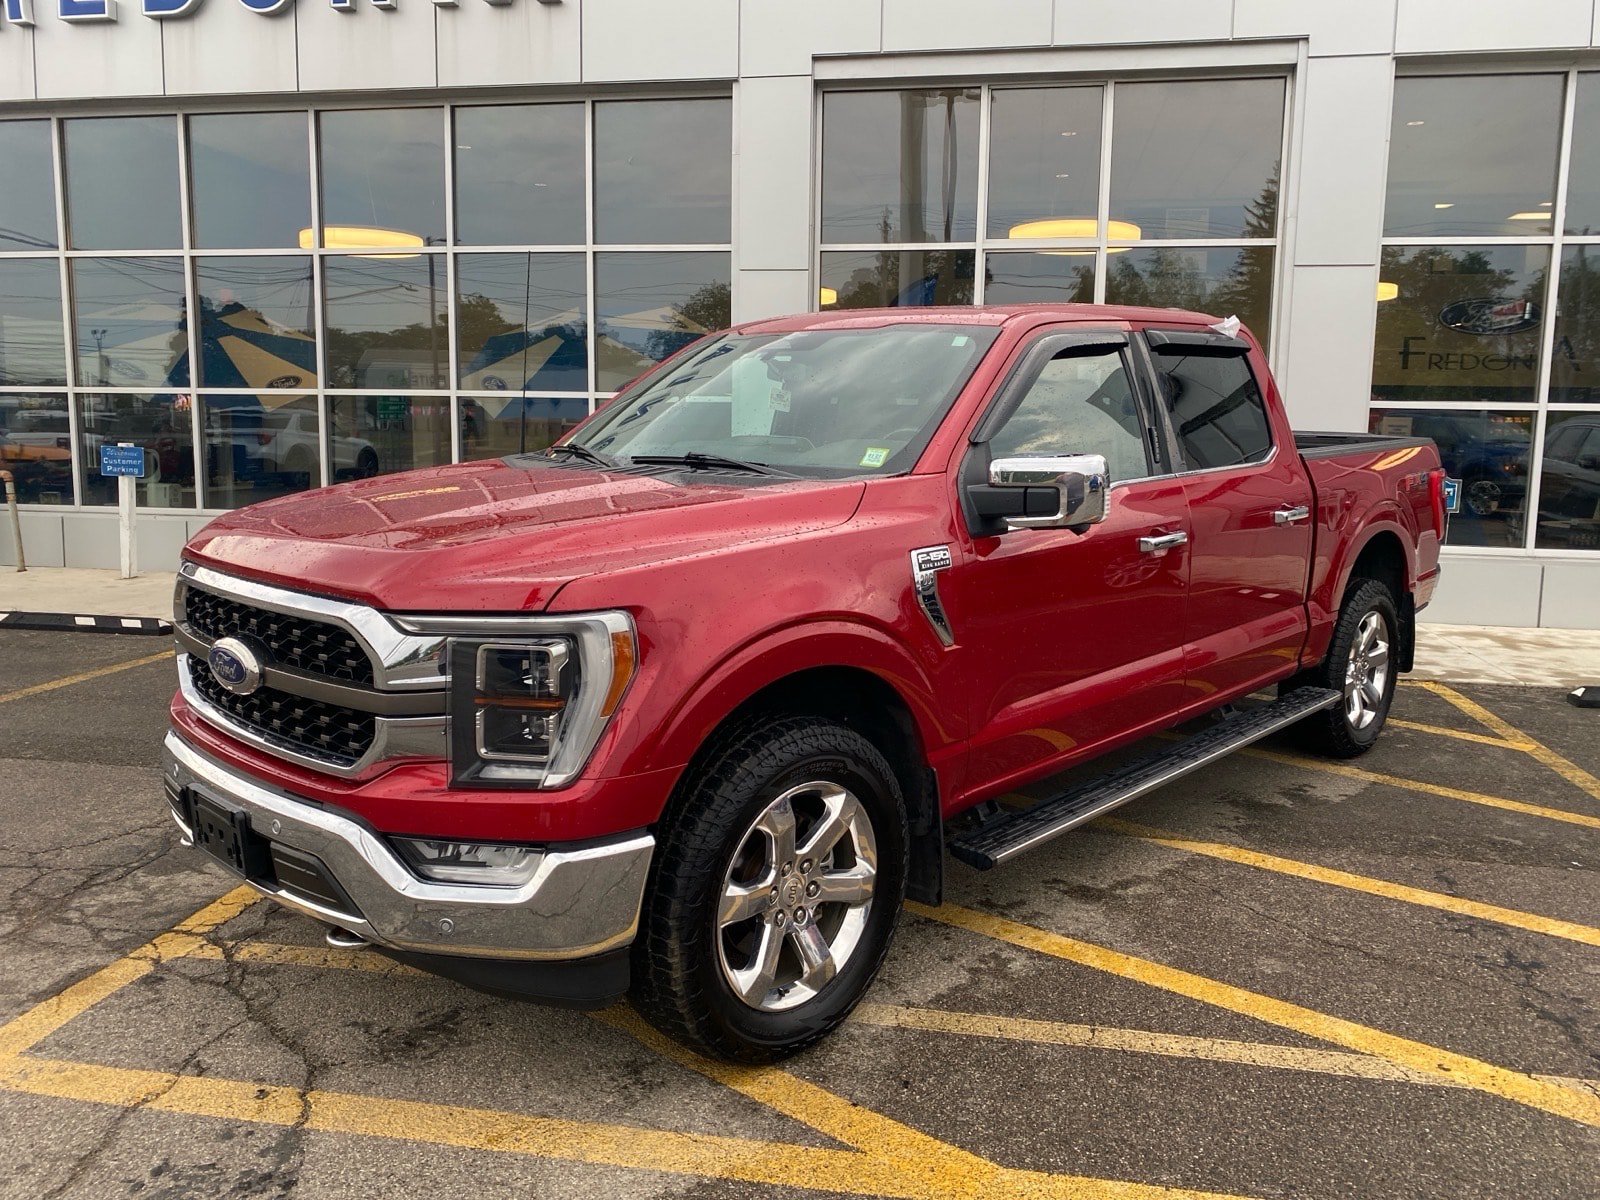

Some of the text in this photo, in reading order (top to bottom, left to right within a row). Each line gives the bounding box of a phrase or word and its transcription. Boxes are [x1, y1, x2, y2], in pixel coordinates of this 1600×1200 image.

[1398, 336, 1581, 371] FREDONA
[103, 457, 142, 465] Customer
[106, 465, 139, 474] Parking
[918, 550, 949, 563] F-150
[214, 651, 237, 679] Ford
